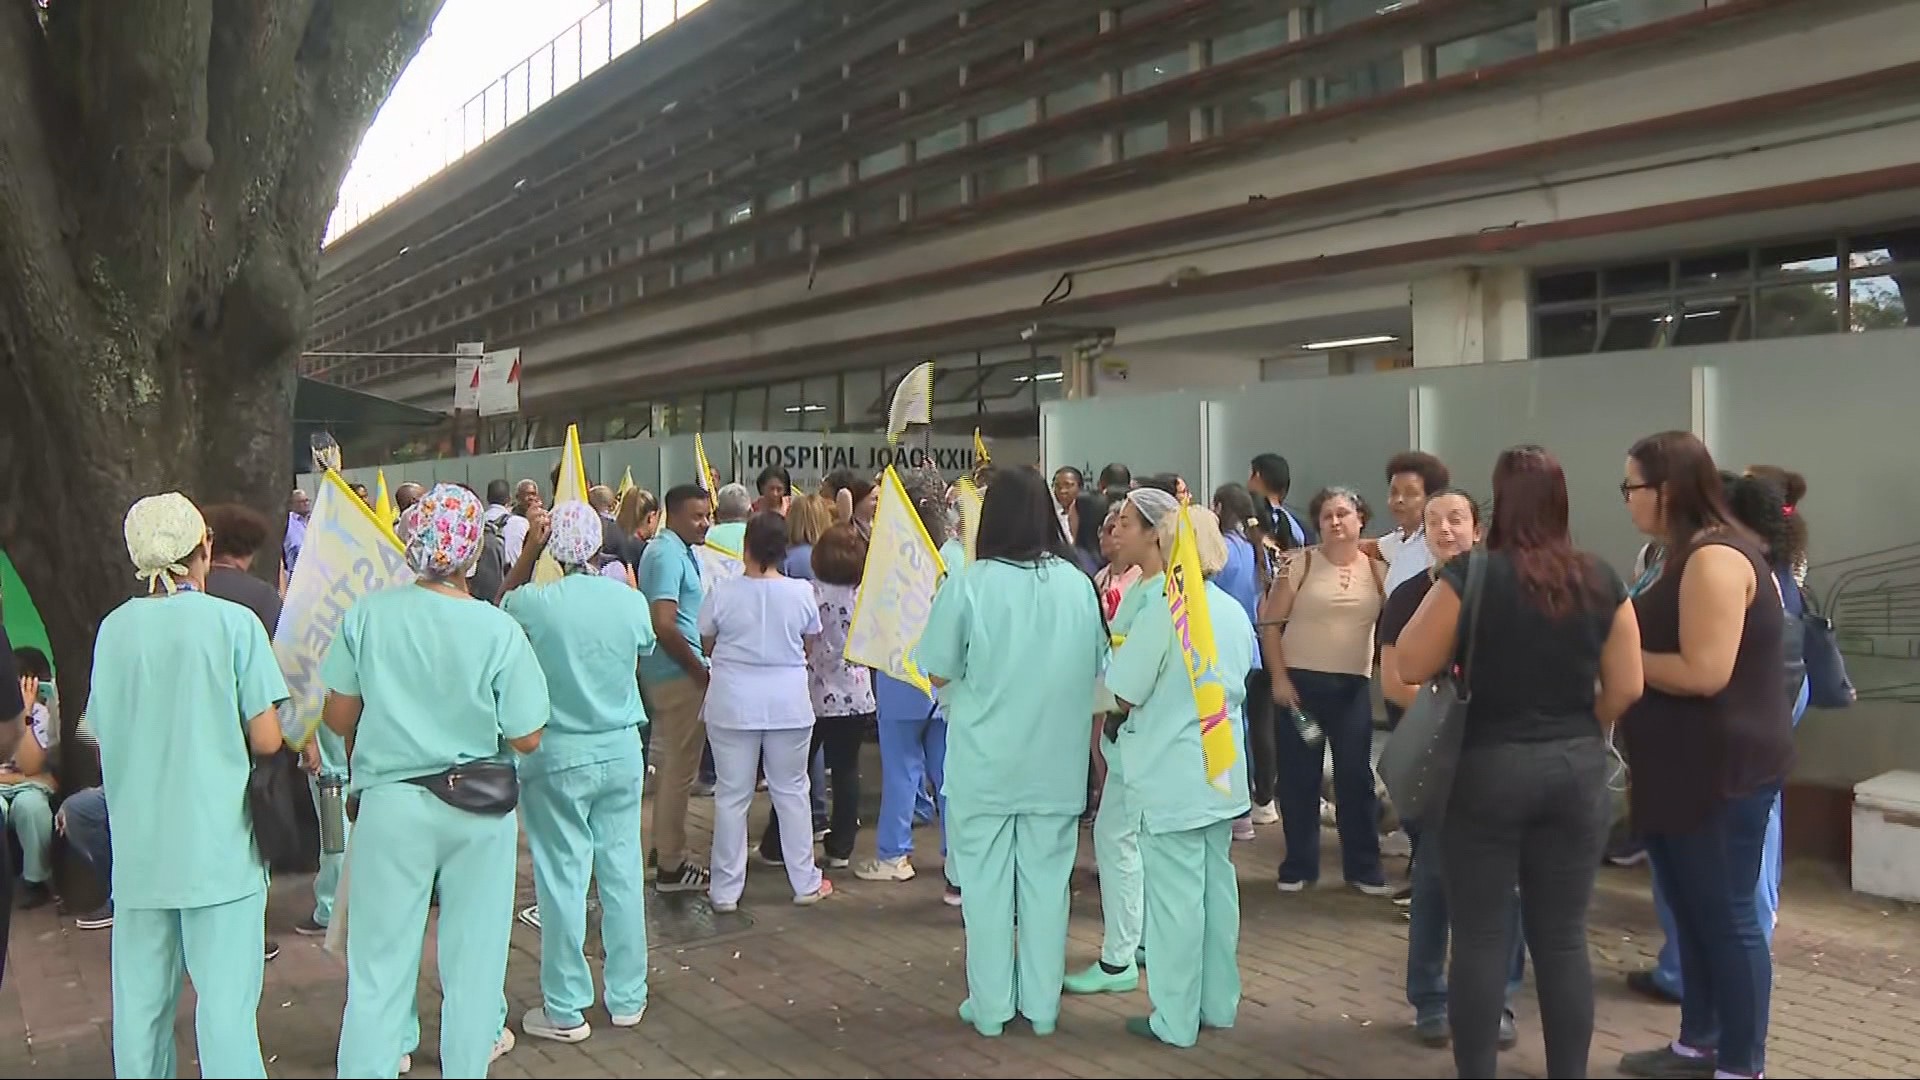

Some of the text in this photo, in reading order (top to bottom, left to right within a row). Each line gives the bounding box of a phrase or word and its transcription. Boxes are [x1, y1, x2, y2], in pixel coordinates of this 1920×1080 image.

[748, 441, 975, 471] HOSPITAL JOÃO XXII
